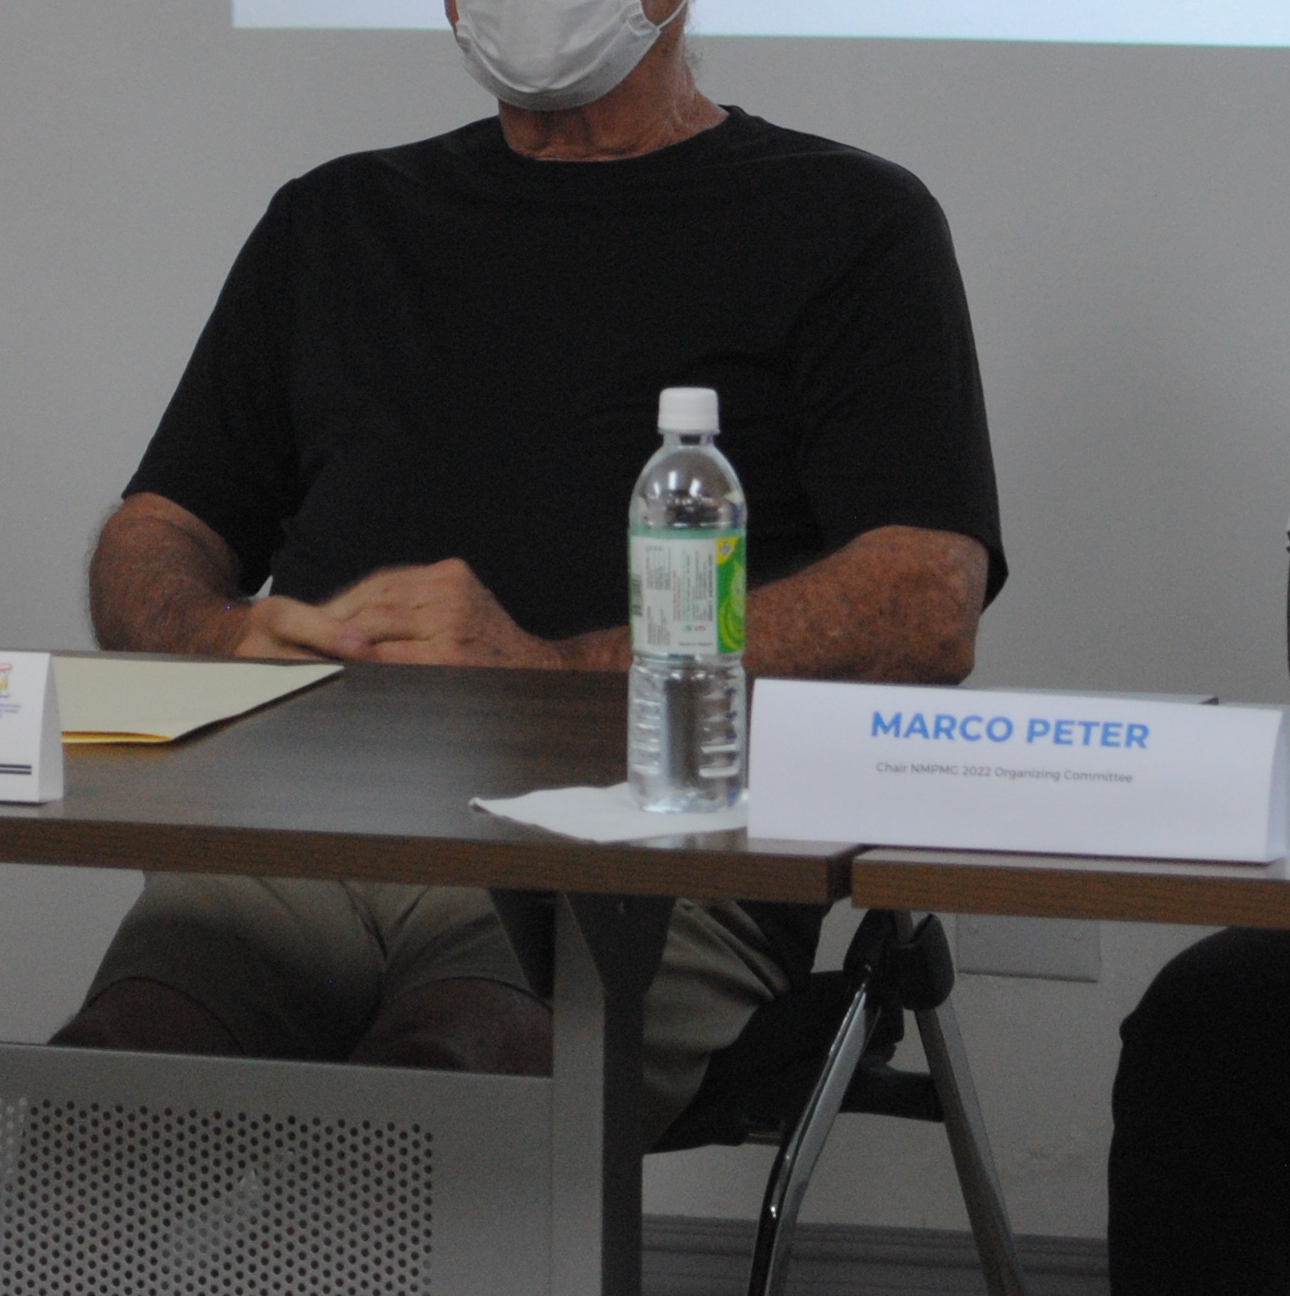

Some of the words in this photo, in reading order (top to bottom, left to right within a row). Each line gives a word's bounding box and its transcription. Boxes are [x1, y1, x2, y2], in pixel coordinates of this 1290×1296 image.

[870, 711, 1014, 743] MARCO
[1026, 718, 1151, 748] PETER
[876, 762, 908, 774] Chair
[910, 763, 959, 775] NMPMG
[962, 765, 992, 777] 2022
[994, 766, 1061, 783] Organizing
[1063, 769, 1133, 783] Committee
